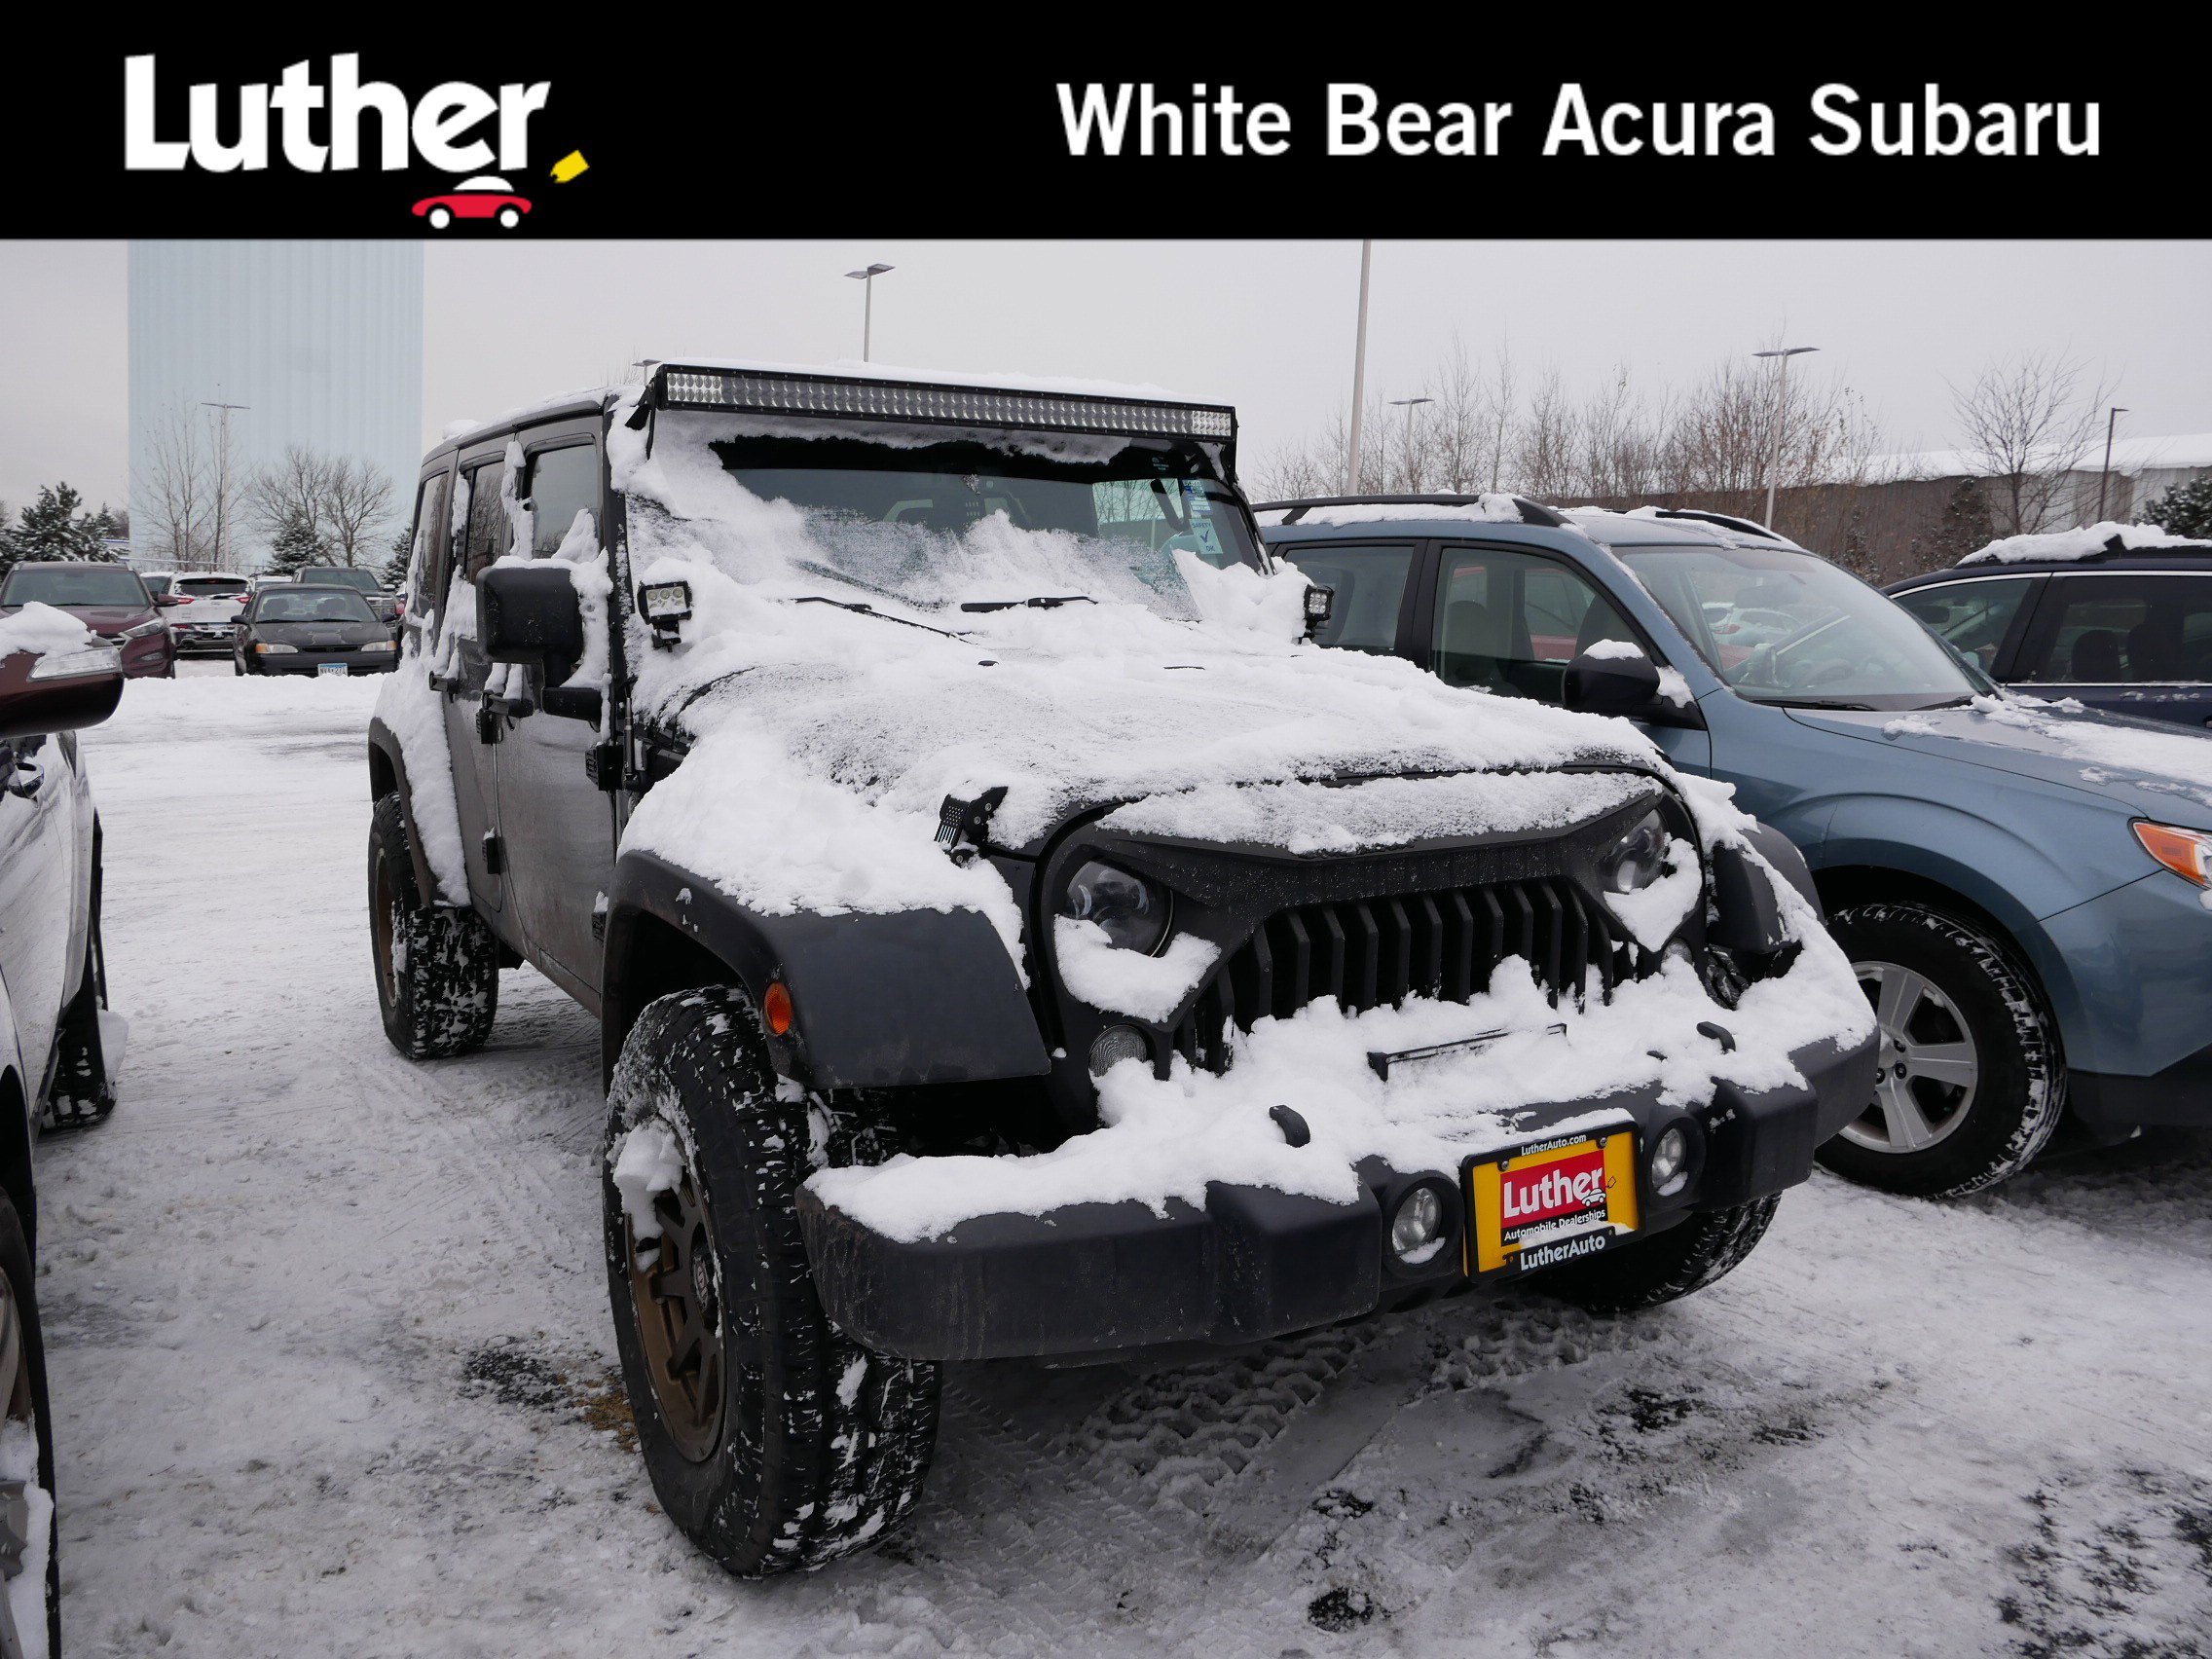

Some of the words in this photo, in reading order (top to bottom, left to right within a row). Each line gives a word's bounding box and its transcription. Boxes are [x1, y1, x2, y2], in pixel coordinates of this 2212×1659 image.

[1521, 1133, 1587, 1157] LutherAuto.com
[1503, 1167, 1603, 1219] Luther
[1504, 1221, 1558, 1241] Automobile
[1558, 1208, 1606, 1229] Dealerships
[1520, 1234, 1606, 1271] LutherAuto
